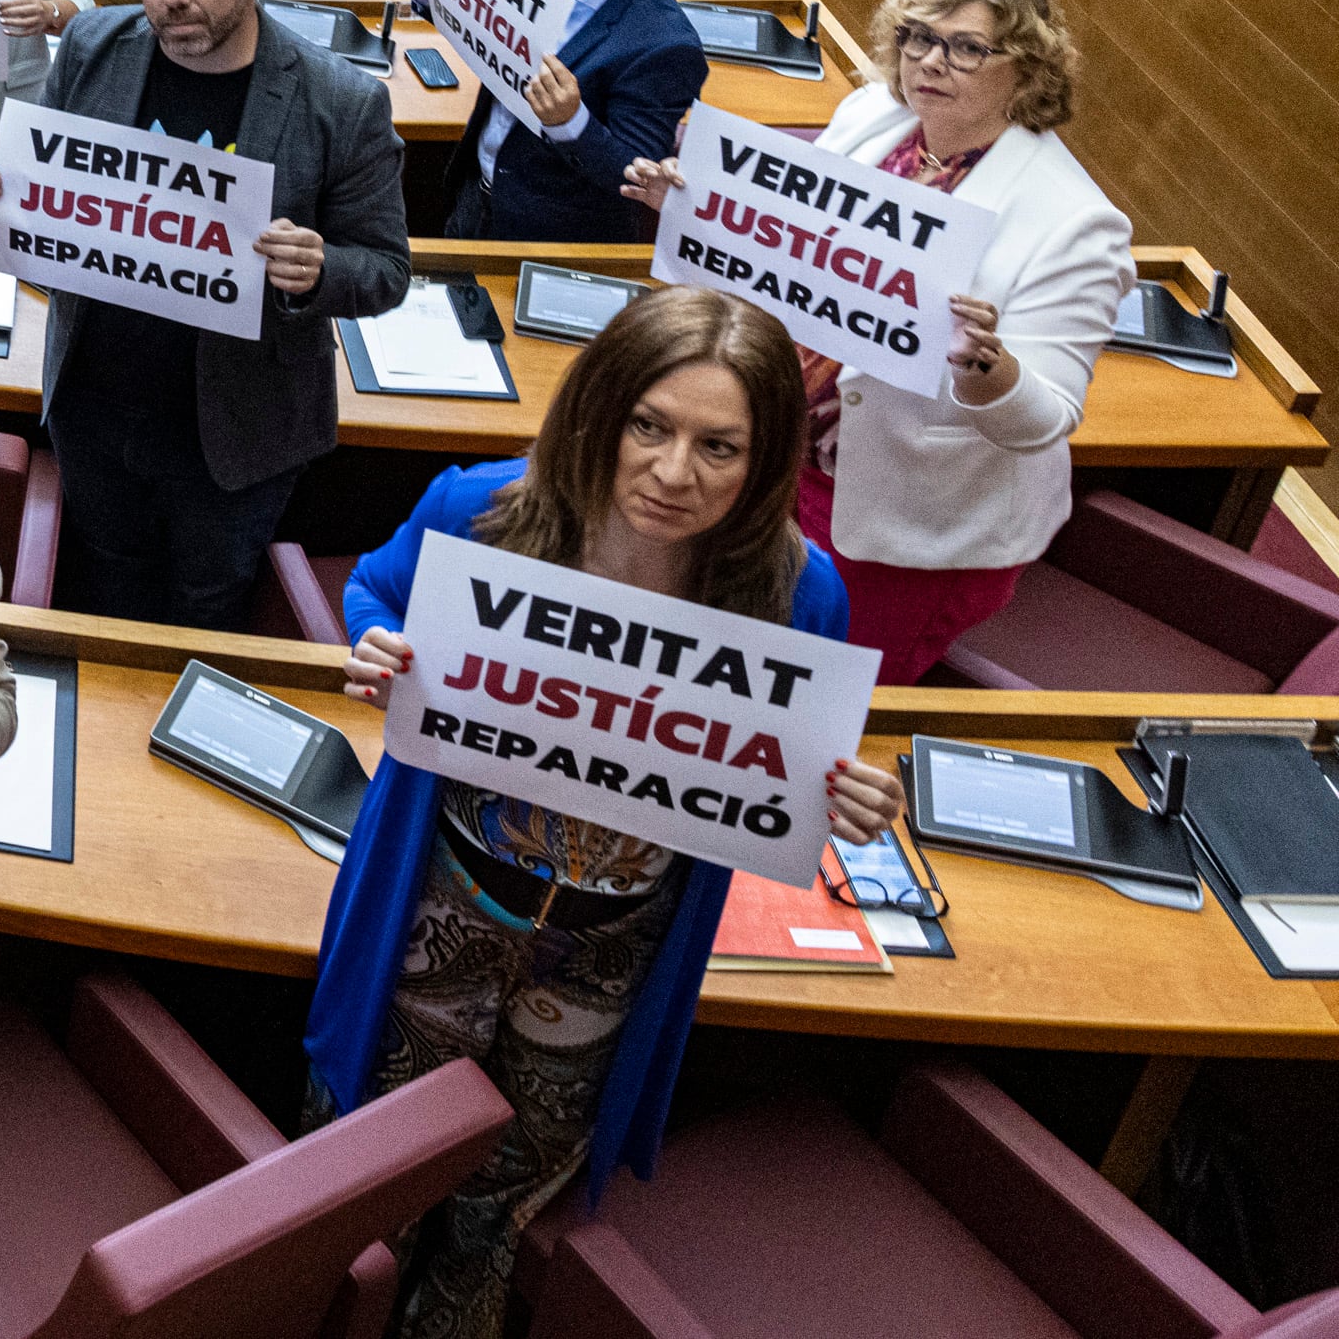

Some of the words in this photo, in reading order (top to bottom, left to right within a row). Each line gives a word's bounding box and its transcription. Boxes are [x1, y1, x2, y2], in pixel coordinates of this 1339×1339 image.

[20, 181, 234, 258] JUSTÍCIA
[30, 127, 236, 203] VERITAT
[718, 137, 947, 251] VERITAT
[9, 227, 240, 304] REPARACIÓ
[677, 234, 922, 358] REPARACIÓ
[693, 190, 919, 310] JUSTÍCIA
[469, 577, 812, 709] VERITAT
[420, 706, 791, 839] REPARACIÓ
[443, 654, 789, 782] JUSTÍCIA
